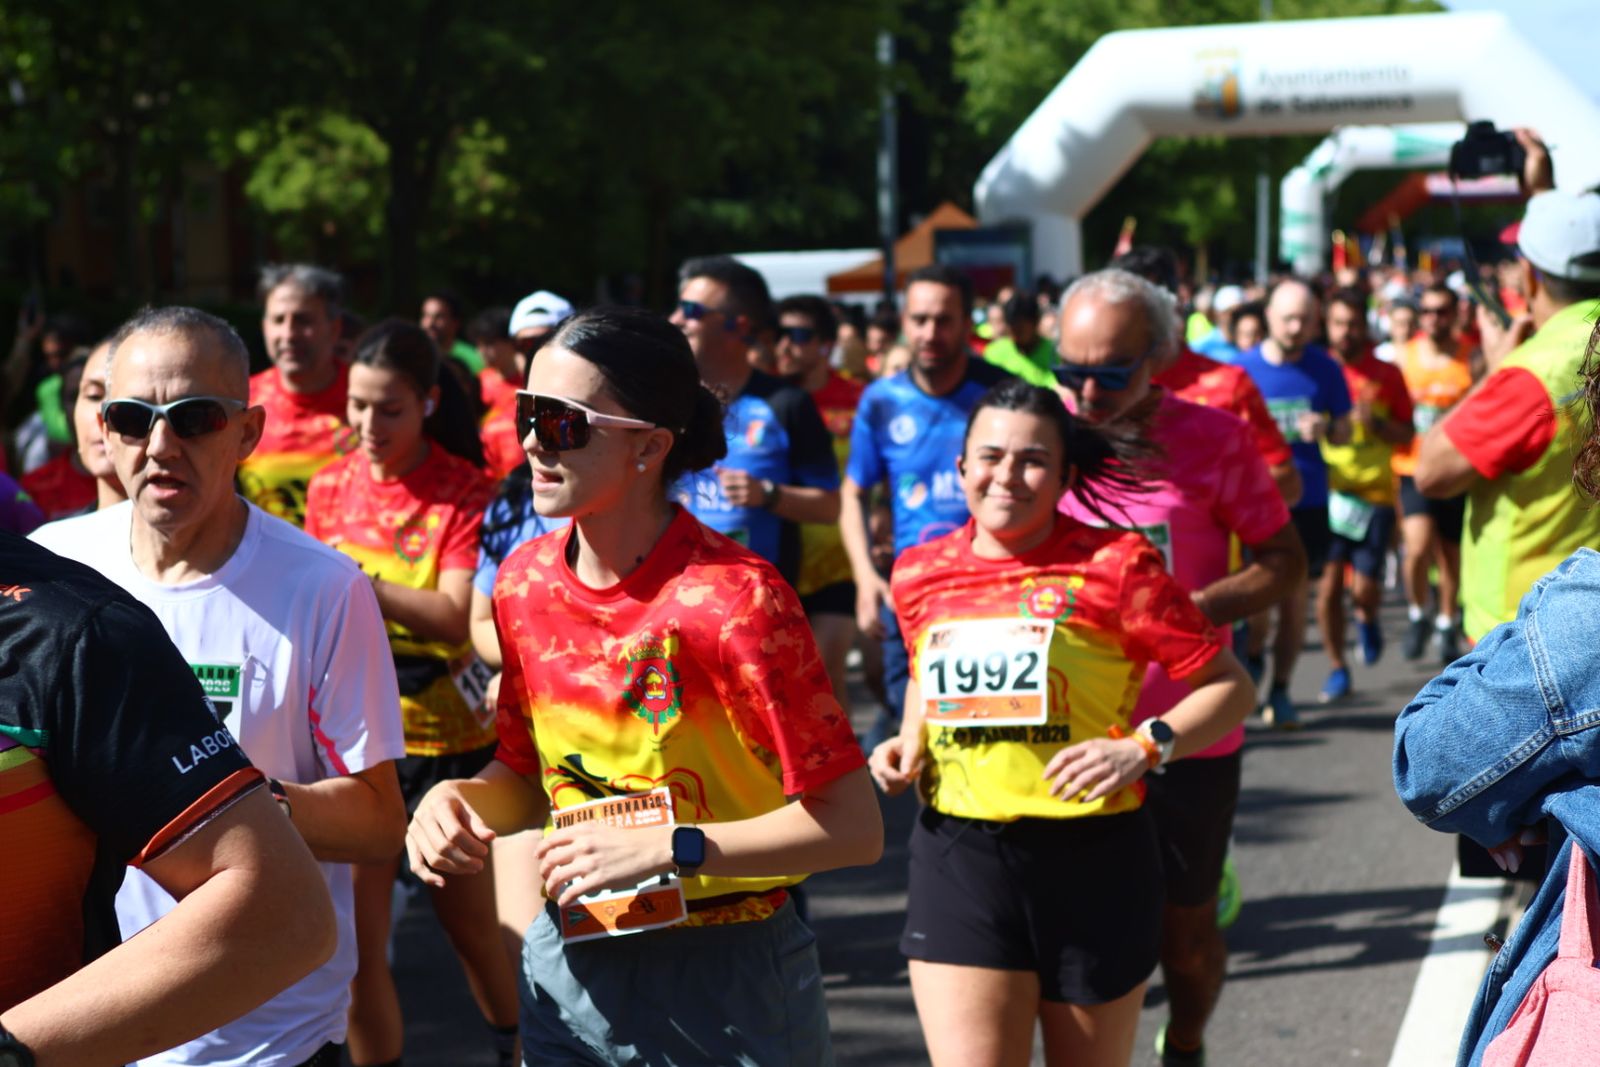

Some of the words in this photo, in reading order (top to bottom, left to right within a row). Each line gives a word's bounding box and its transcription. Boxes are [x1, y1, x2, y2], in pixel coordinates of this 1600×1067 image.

[197, 667, 235, 679] ANDO
[928, 651, 1039, 695] 1992
[577, 808, 594, 822] SAN
[603, 795, 661, 817] FERNANDO
